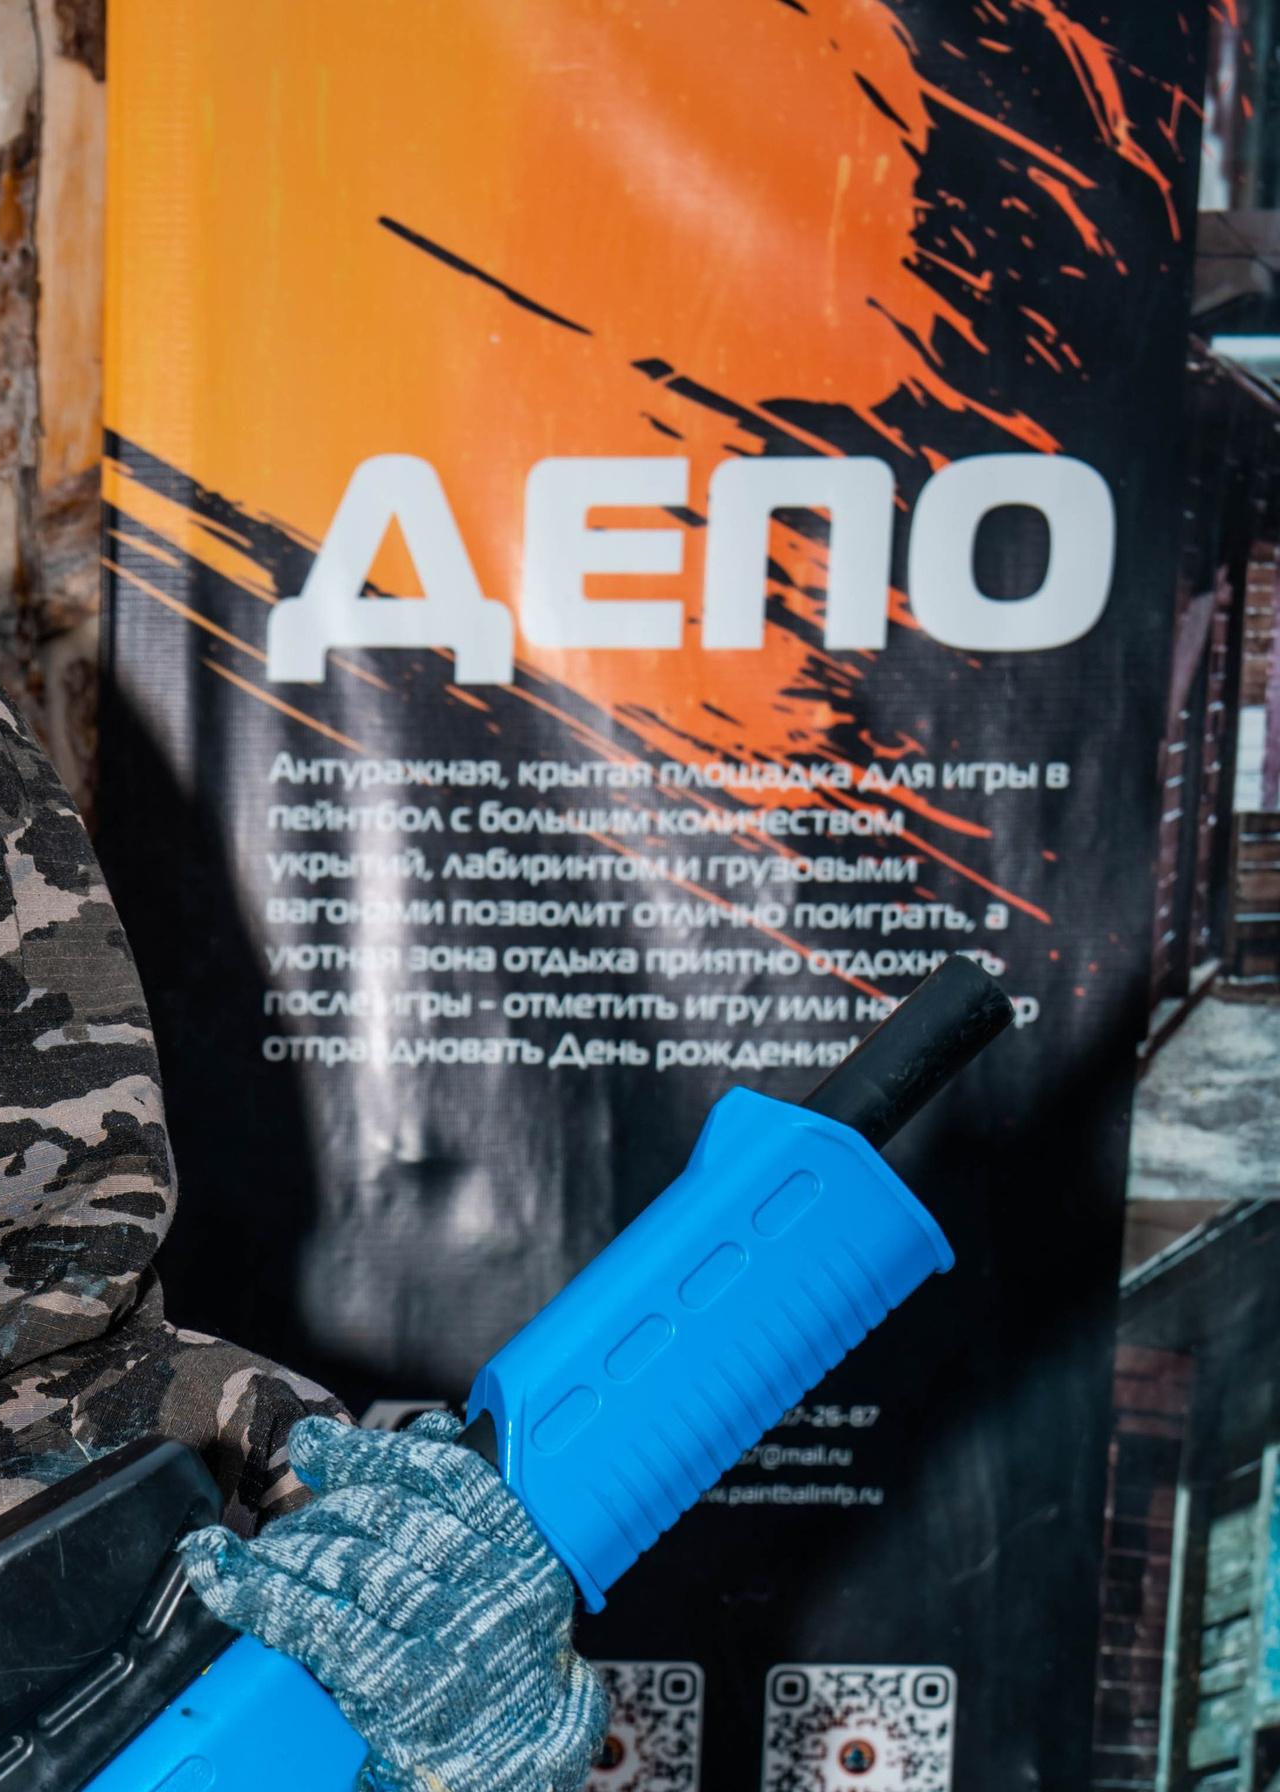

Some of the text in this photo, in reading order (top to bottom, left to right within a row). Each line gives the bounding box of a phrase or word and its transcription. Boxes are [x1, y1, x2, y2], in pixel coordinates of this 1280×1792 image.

[267, 452, 1116, 684] ДЕПО
[267, 752, 1070, 795] Антуражная, крытая площадка для игры в
[266, 800, 905, 837] пейнтбол с большим количеством
[441, 847, 667, 886] лабиринтом
[673, 855, 700, 882] и
[707, 855, 919, 888] грузовыми
[451, 899, 626, 929] позволит
[632, 901, 788, 930] отлично
[794, 903, 977, 936] поиграть,
[984, 903, 1010, 931] а
[263, 943, 1007, 980] уютная зона отдыха приятно отдохнть
[262, 989, 371, 1018] после
[502, 991, 680, 1020] отметить
[684, 995, 768, 1027] игру
[777, 995, 848, 1023] или
[261, 1034, 545, 1069] отпрадновать
[548, 1032, 651, 1070] День
